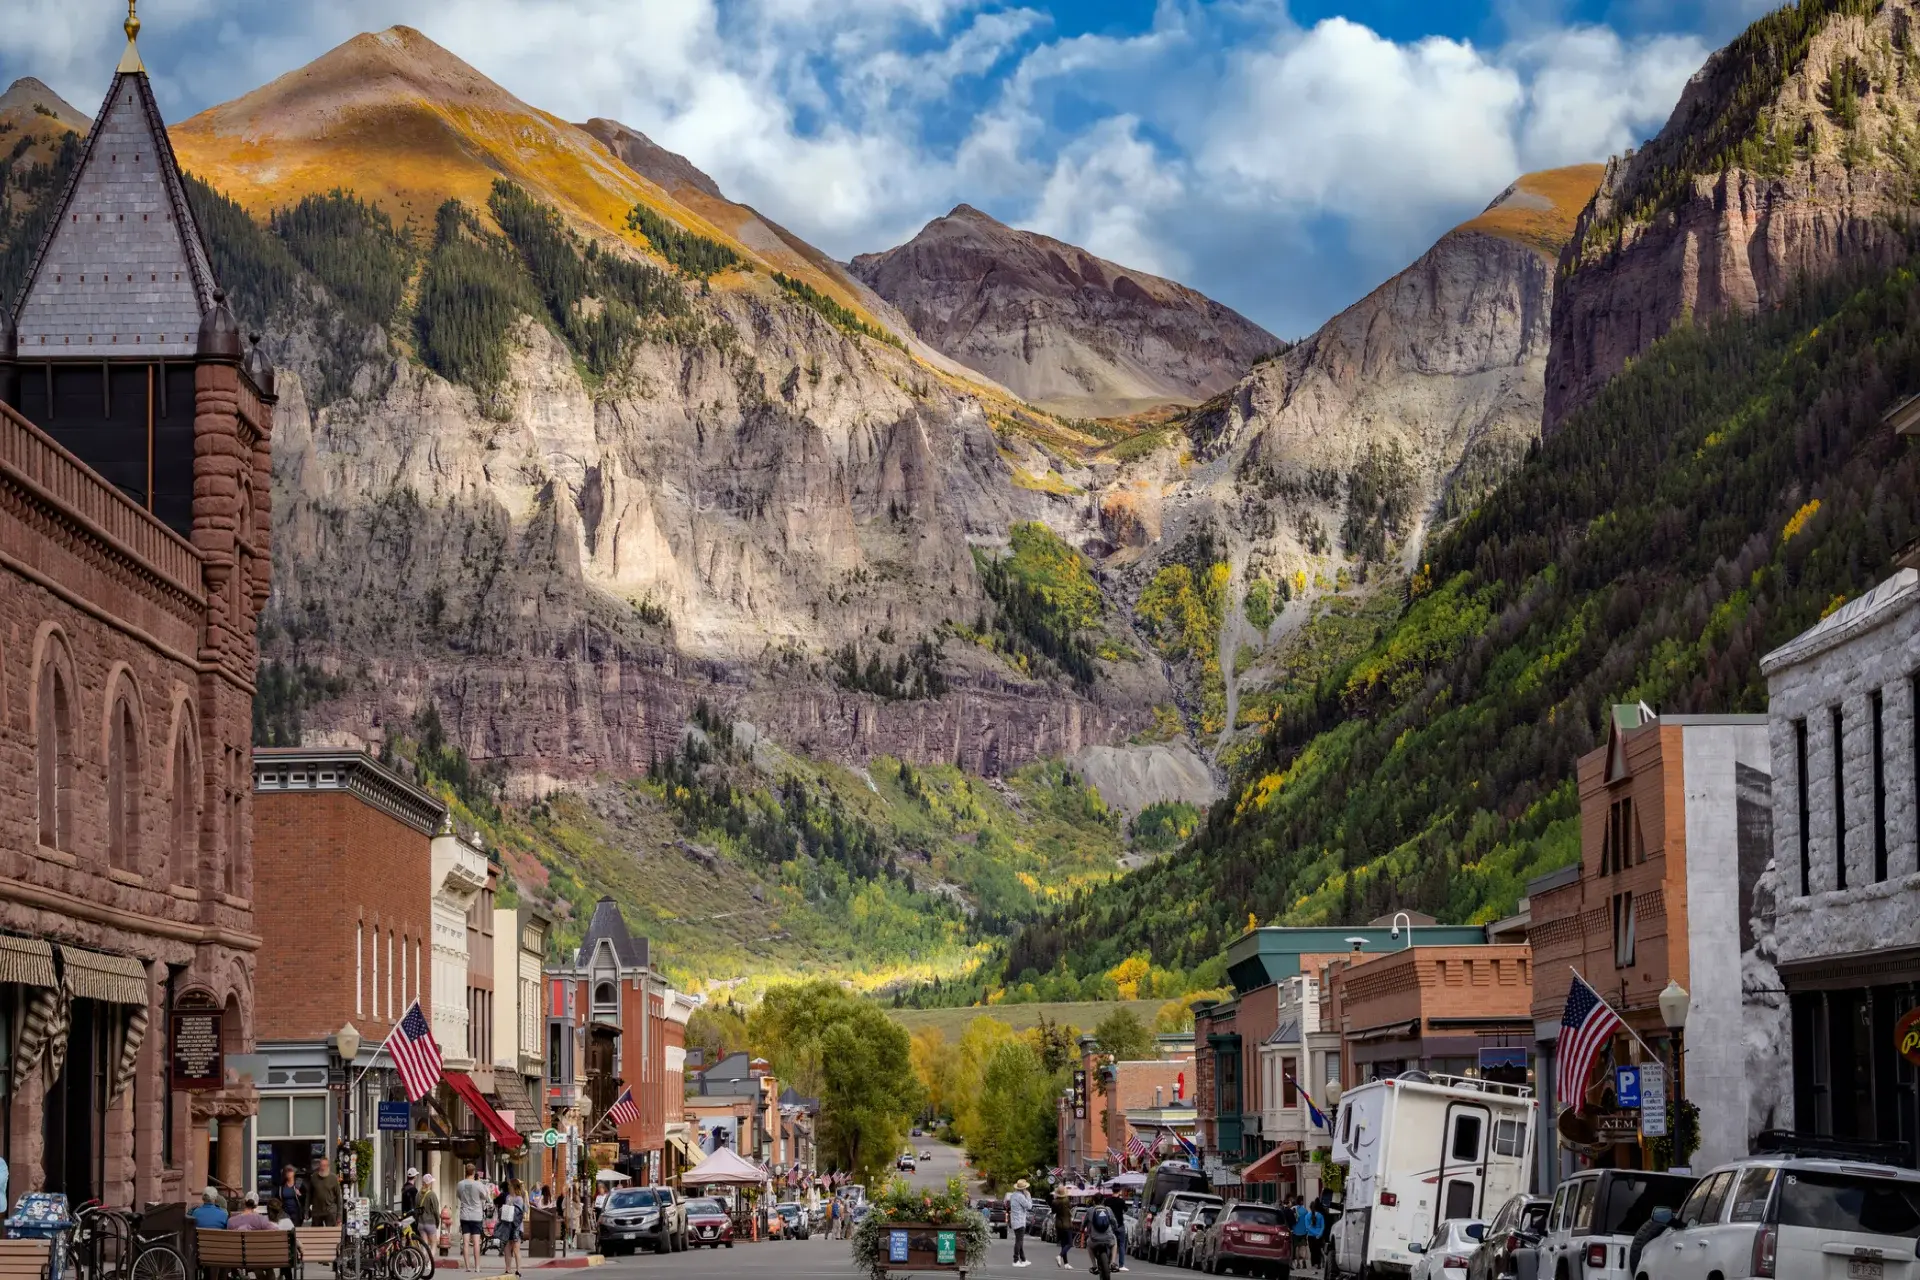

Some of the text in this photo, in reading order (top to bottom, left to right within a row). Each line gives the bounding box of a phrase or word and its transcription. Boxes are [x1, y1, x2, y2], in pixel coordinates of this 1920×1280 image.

[1620, 1071, 1635, 1093] P
[1786, 1175, 1797, 1185] 18
[1854, 1247, 1883, 1258] GMC
